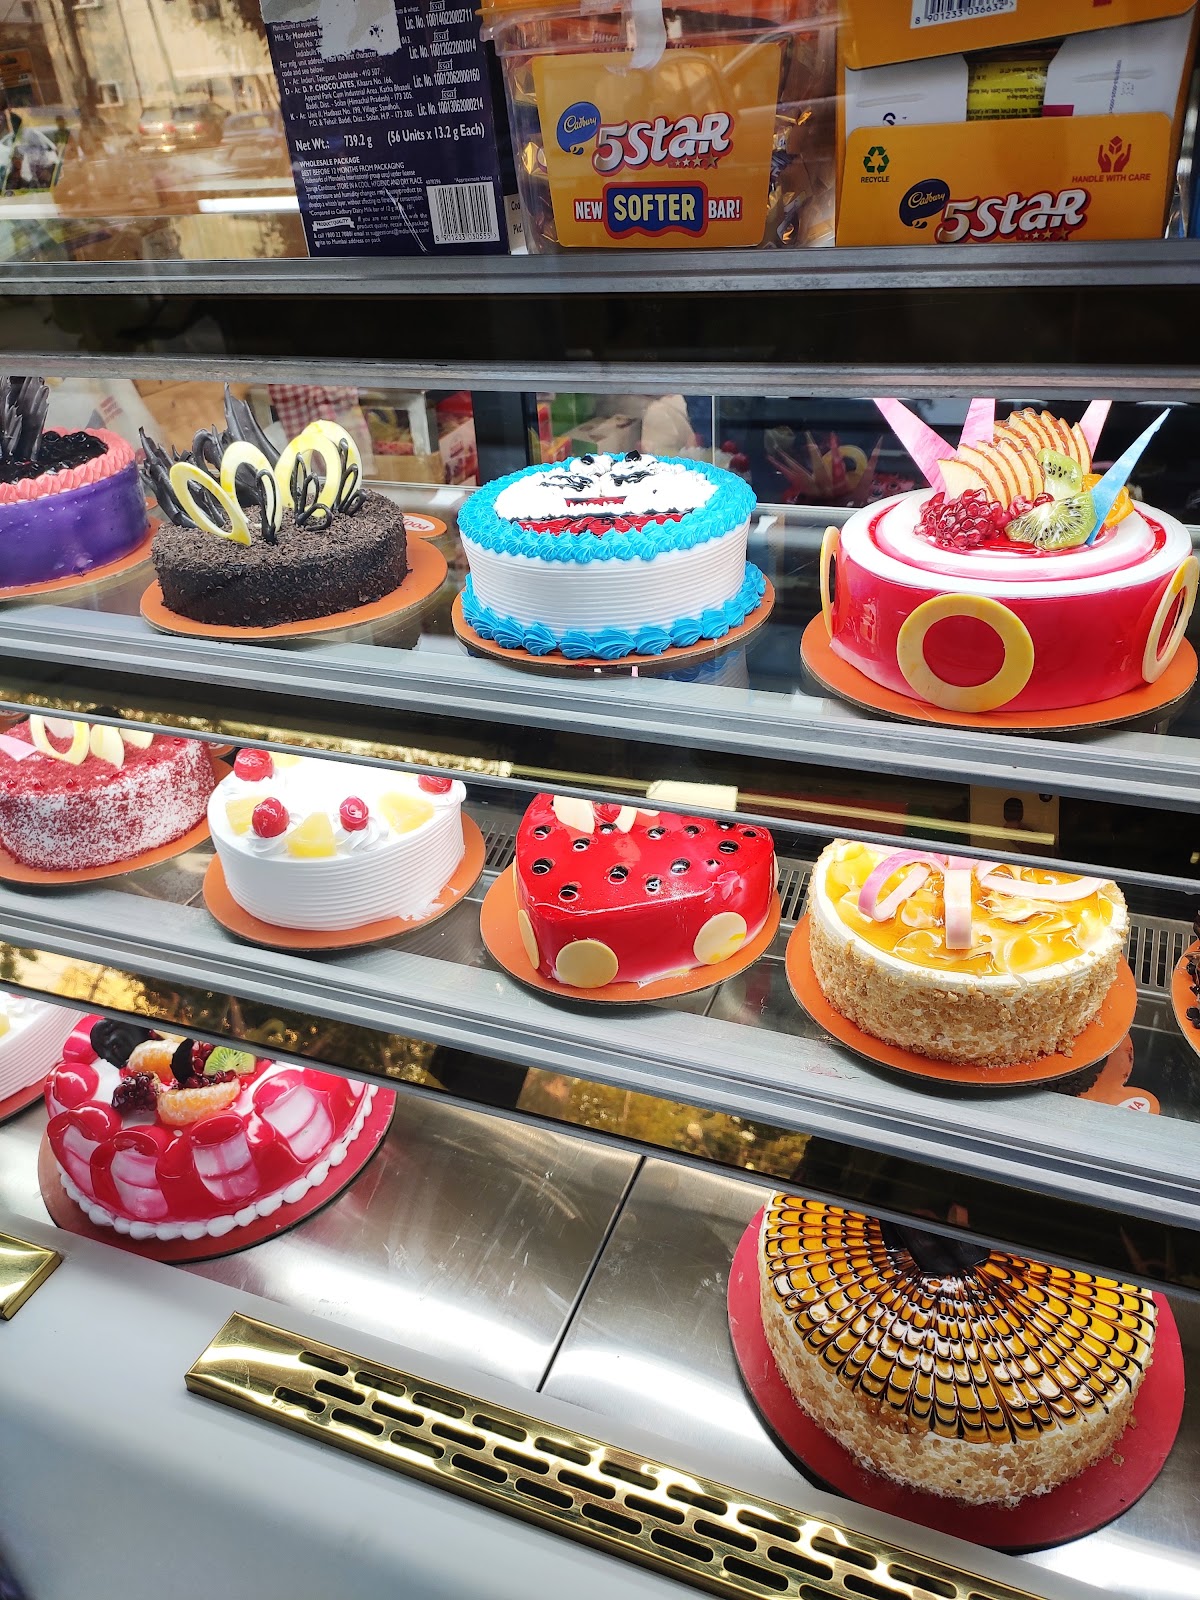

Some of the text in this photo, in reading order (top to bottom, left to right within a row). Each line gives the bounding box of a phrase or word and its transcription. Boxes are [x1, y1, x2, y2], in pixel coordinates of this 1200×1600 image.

[405, 16, 415, 30] Lic.
[415, 15, 425, 28] No.
[292, 30, 317, 40] Mondelez
[409, 46, 419, 59] Lic.
[419, 45, 430, 58] No.
[315, 80, 356, 90] CHOCOLATES,
[413, 75, 423, 88] Lic.
[424, 74, 433, 87] No.
[417, 103, 427, 116] Lic.
[428, 102, 437, 116] No.
[564, 114, 597, 134] Cadbury
[295, 139, 311, 152] Net
[344, 134, 365, 147] 739.2
[368, 136, 373, 148] g
[388, 130, 400, 146] (56
[402, 128, 425, 142] Units
[434, 126, 451, 139] 13.2
[453, 129, 459, 140] g
[460, 122, 485, 138] Each)
[299, 156, 360, 168] WHOLESALE PACKAGE
[374, 162, 404, 171] PACKAGING
[908, 190, 945, 208] Cadbury
[576, 201, 603, 220] NEW
[614, 193, 696, 221] SOFTER
[708, 199, 740, 219] BAR!
